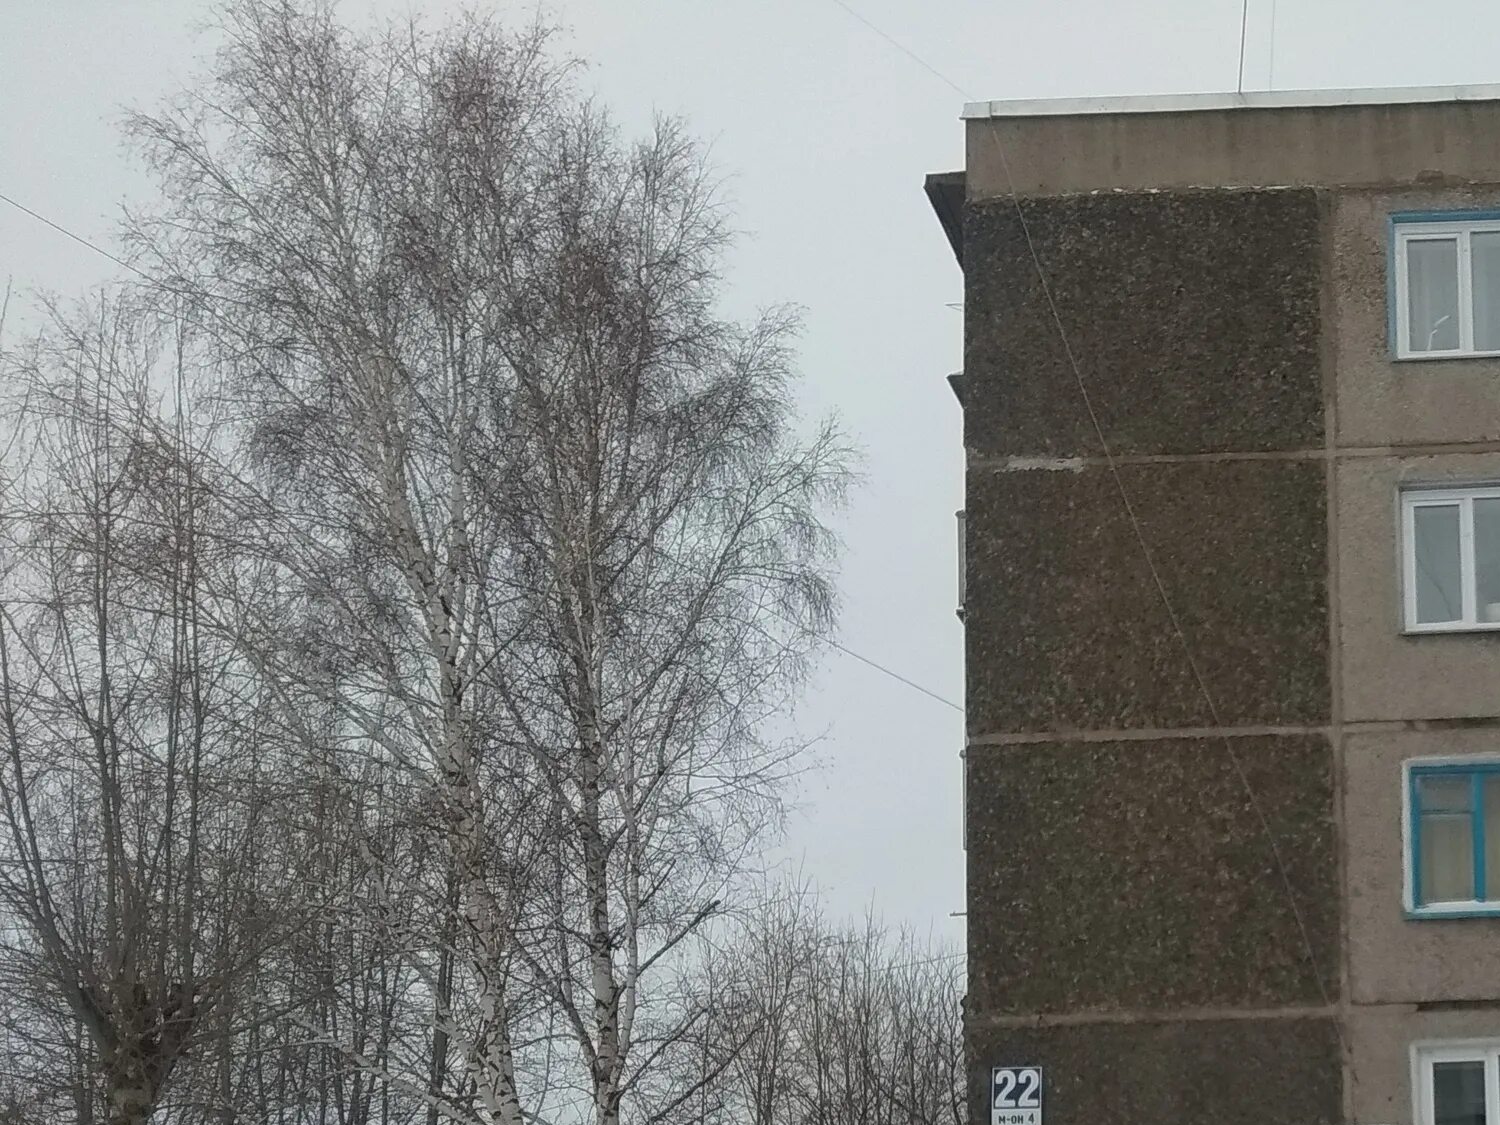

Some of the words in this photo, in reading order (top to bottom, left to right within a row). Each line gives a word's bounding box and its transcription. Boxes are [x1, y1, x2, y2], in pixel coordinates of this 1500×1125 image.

[995, 1070, 1039, 1107] 22
[998, 1115, 1024, 1125] М-ОН
[1028, 1112, 1034, 1124] 4
